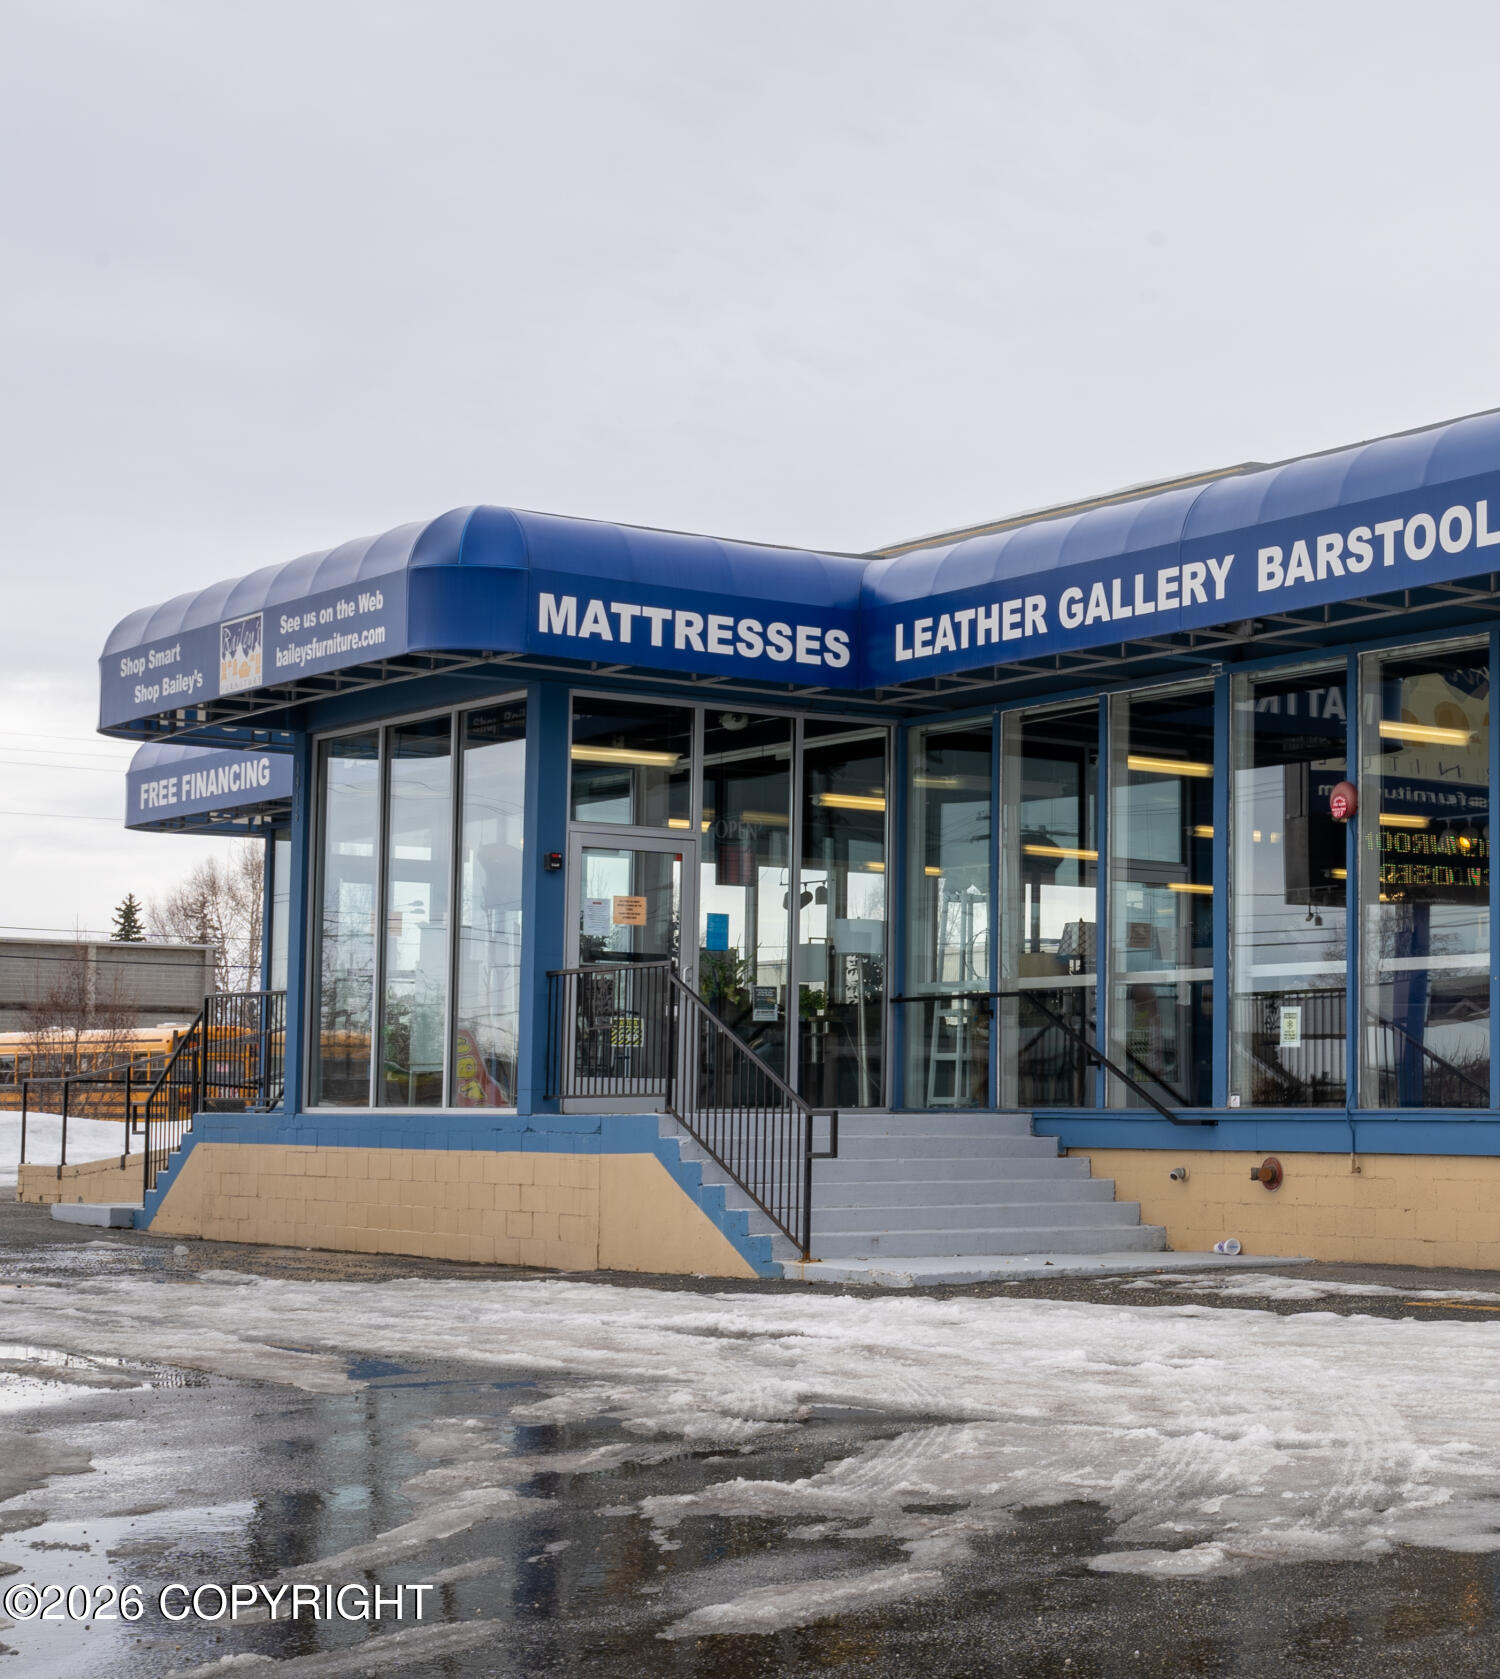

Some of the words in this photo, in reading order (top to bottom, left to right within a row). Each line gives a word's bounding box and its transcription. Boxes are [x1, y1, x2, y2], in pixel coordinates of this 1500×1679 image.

[280, 615, 300, 634] See
[303, 611, 317, 628] us
[319, 607, 334, 624] on
[336, 599, 356, 620] the
[358, 590, 384, 614] Web
[538, 592, 851, 668] MATTRESSES
[895, 594, 1048, 662] LEATHER
[1058, 554, 1236, 630] GALLERY
[120, 657, 146, 677] Shop
[148, 643, 181, 669] Smart
[275, 626, 386, 667] baileysfurniture.com
[134, 684, 160, 704] Shop
[162, 669, 203, 696] Bailey's
[139, 777, 178, 810] FREE
[182, 758, 270, 800] FINANCING
